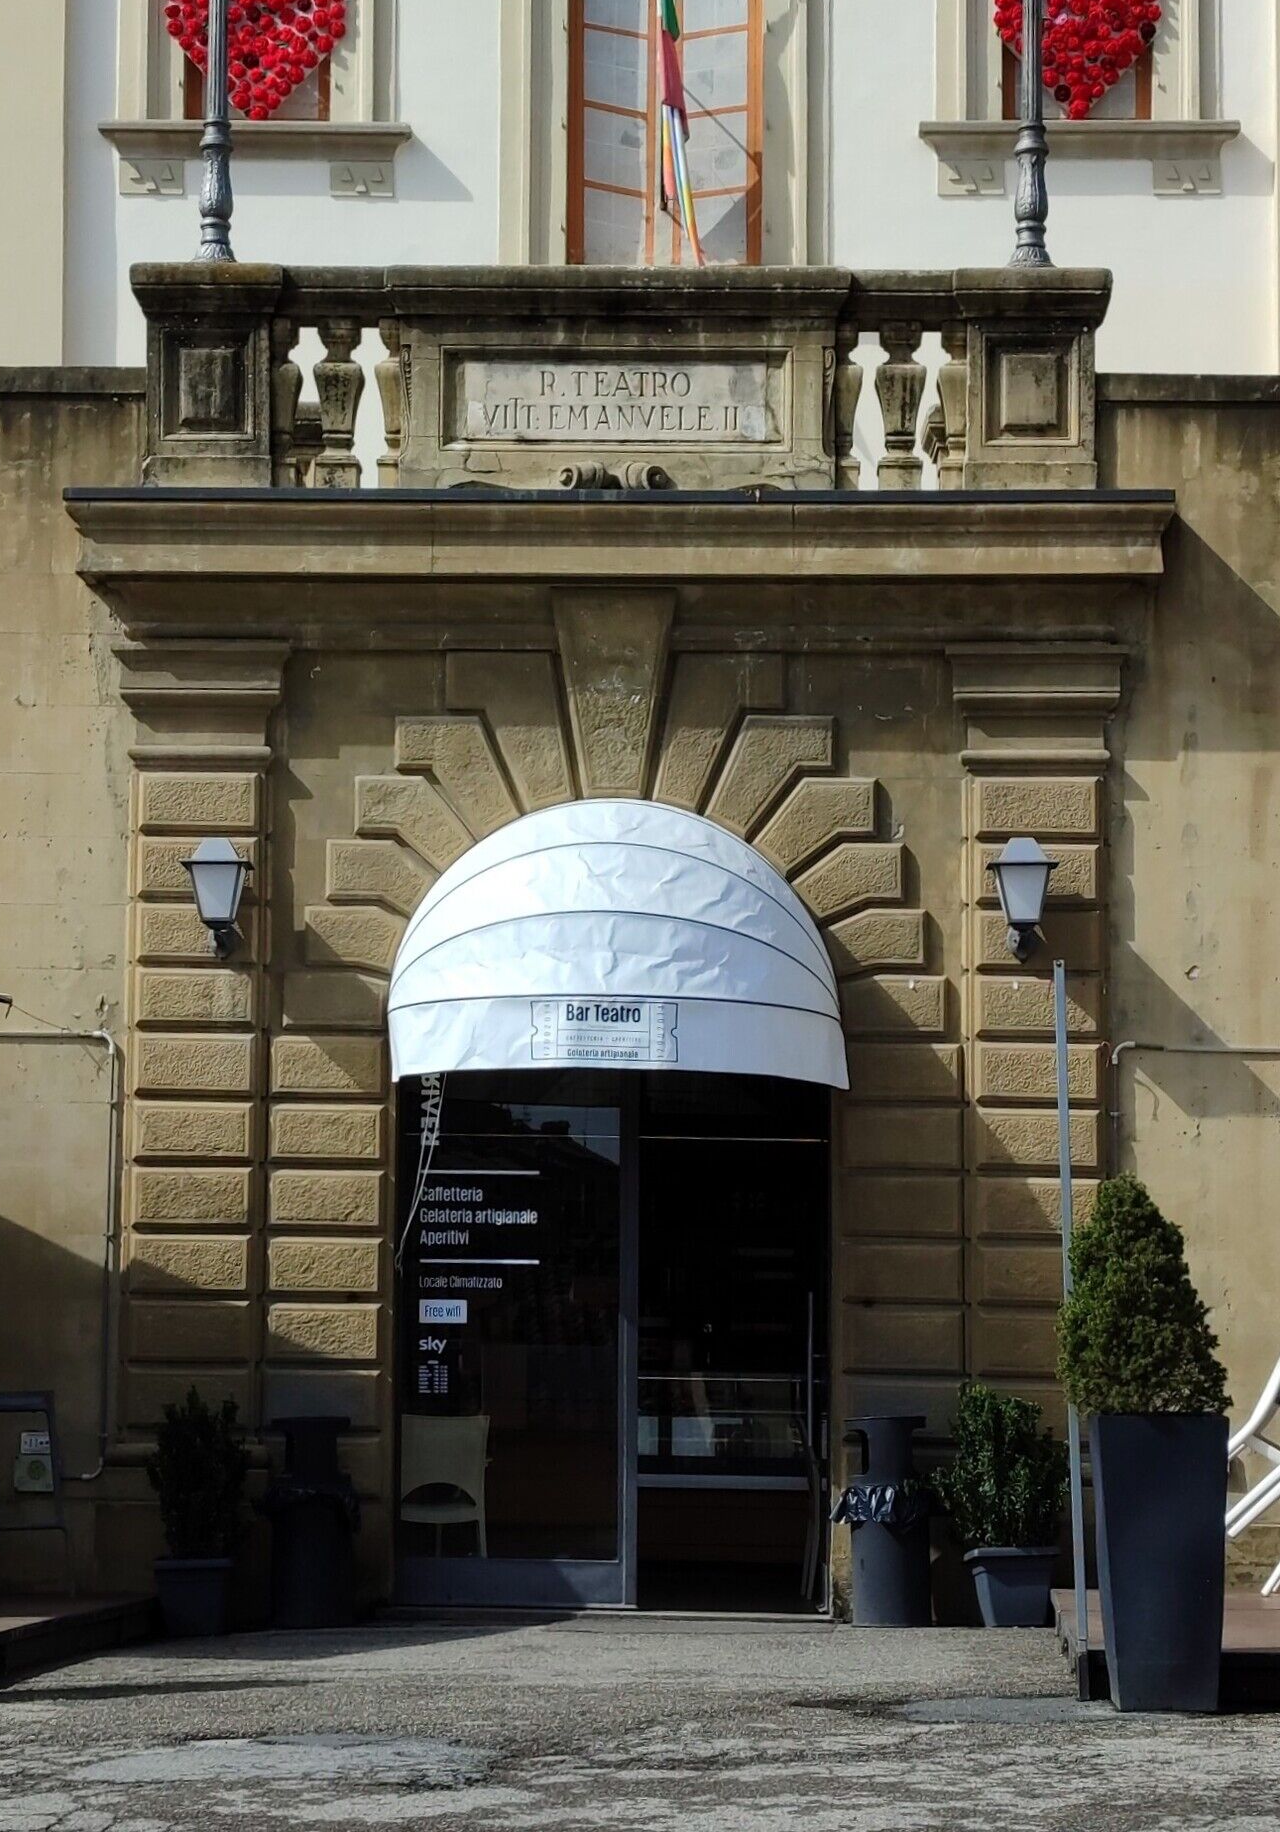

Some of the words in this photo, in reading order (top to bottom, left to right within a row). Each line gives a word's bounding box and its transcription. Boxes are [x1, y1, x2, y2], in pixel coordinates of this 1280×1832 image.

[571, 370, 691, 397] TEATRO
[566, 1003, 590, 1021] Bar
[594, 1004, 641, 1023] Teatro
[420, 1187, 483, 1202] Caffetteria
[420, 1208, 472, 1223] Gelateria
[475, 1208, 538, 1226] artigianale
[420, 1229, 469, 1246] Aperitivi
[419, 1275, 448, 1288] Locale
[449, 1275, 503, 1288] Climatizzato
[424, 1305, 443, 1318] Free
[445, 1306, 461, 1318] wifi
[419, 1335, 448, 1354] sky
